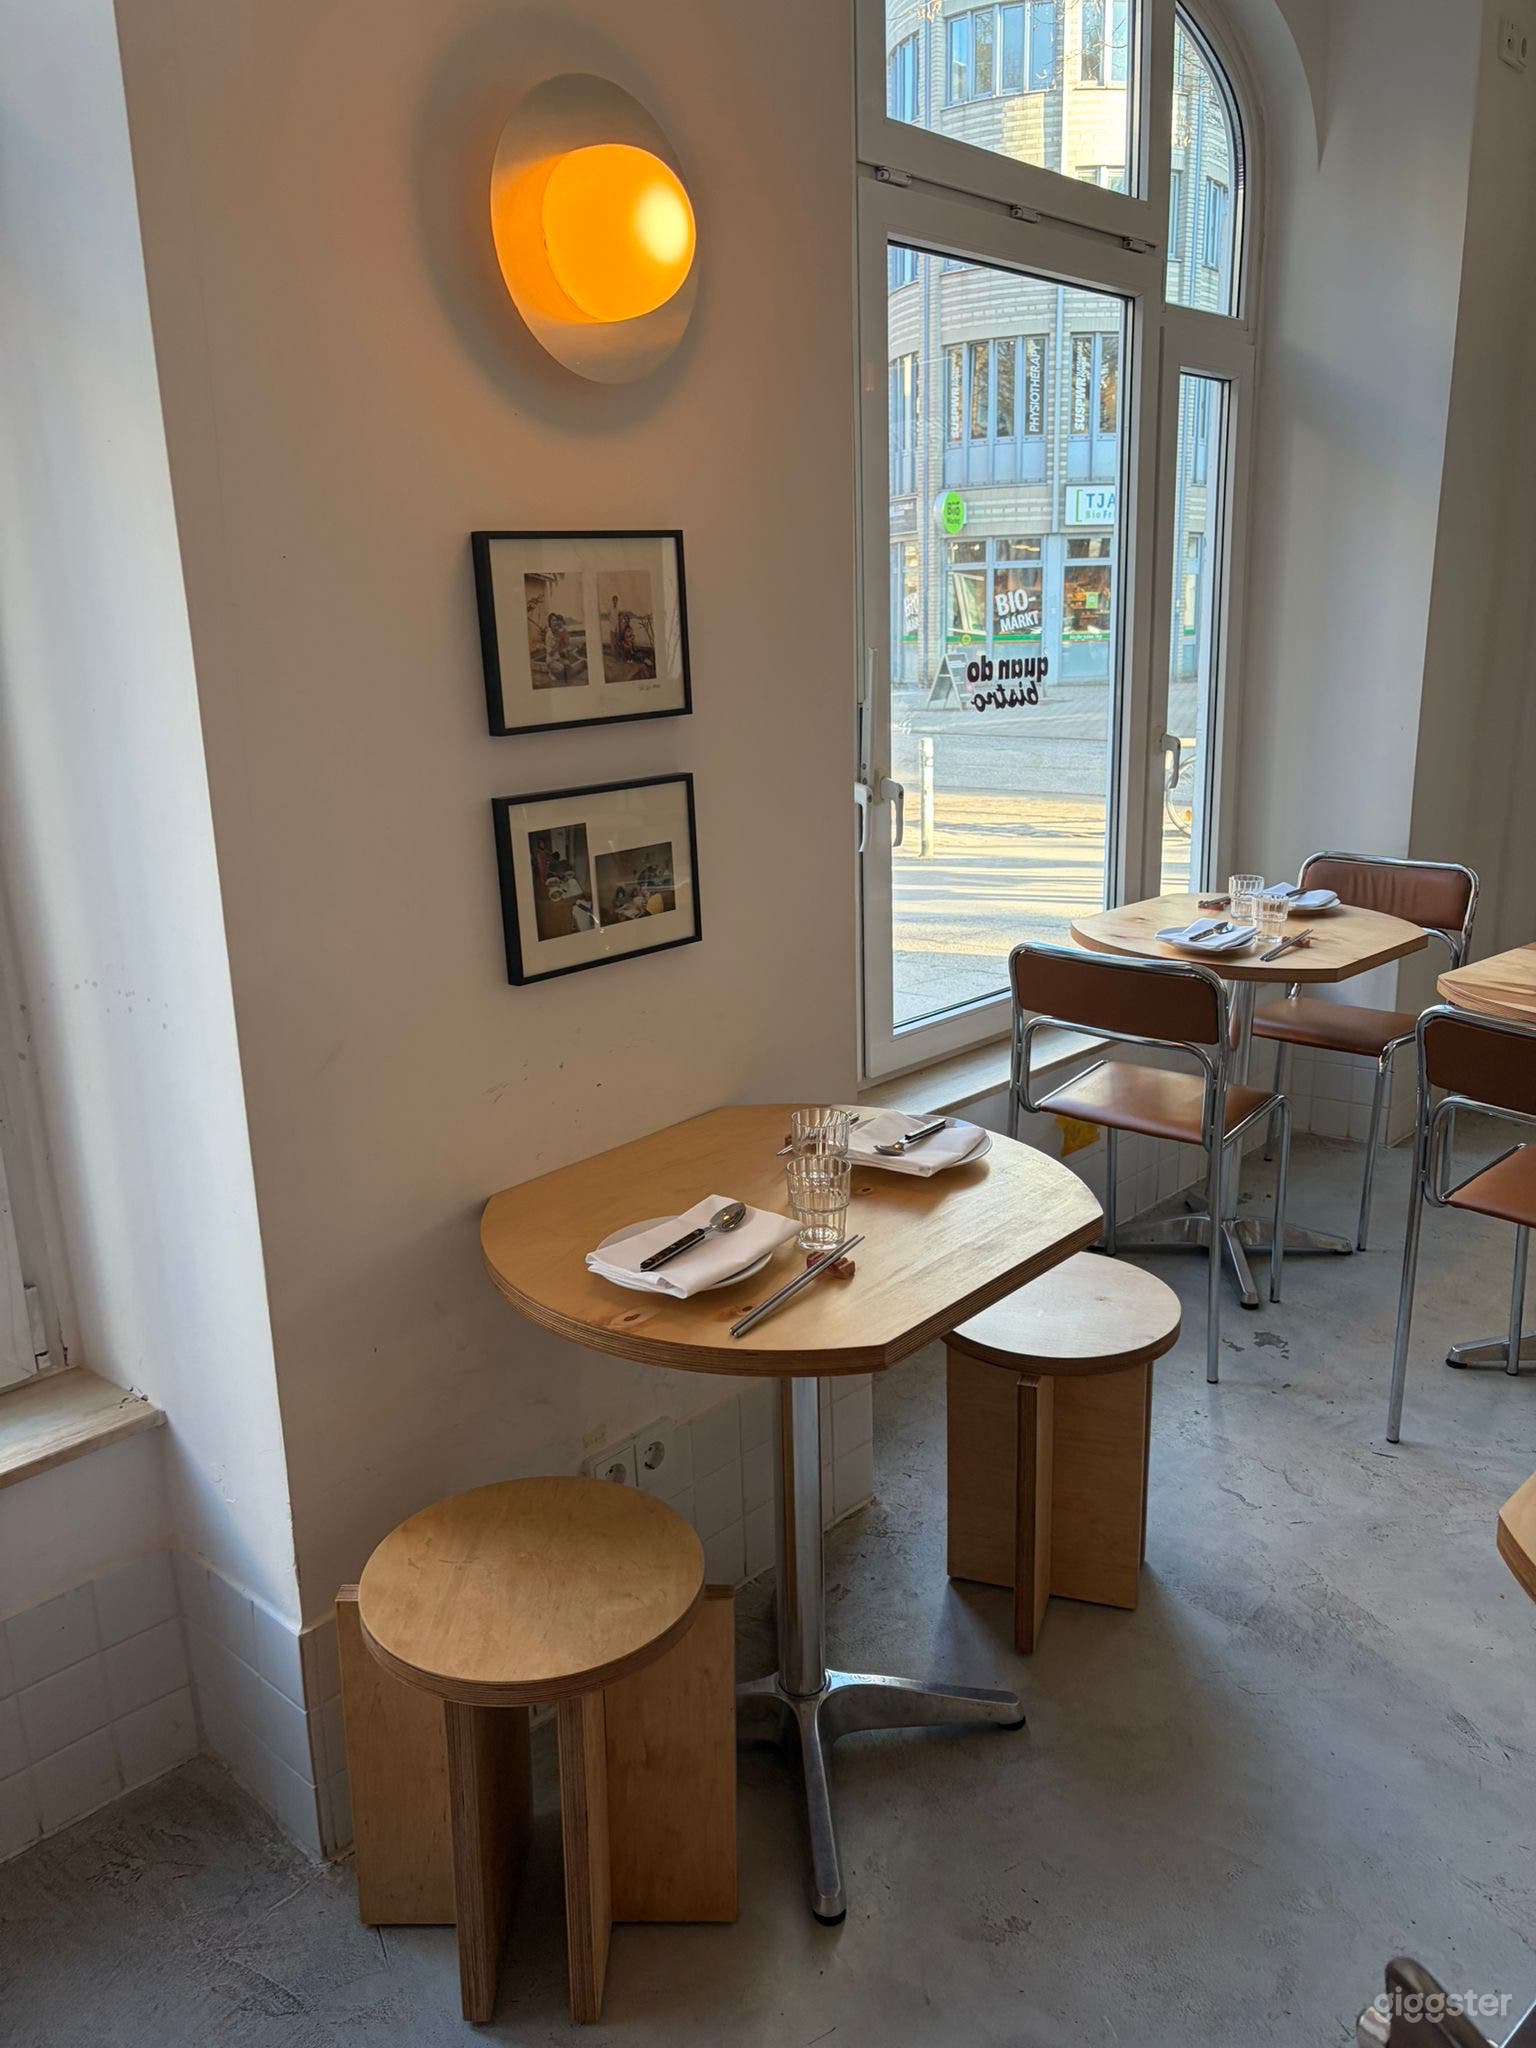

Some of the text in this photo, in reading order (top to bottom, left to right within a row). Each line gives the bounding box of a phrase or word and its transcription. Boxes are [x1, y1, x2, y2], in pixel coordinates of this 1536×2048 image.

[1029, 344, 1041, 432] PHYSIOTHERAPY
[995, 589, 1037, 616] BIO-
[1000, 611, 1039, 633] MARKT
